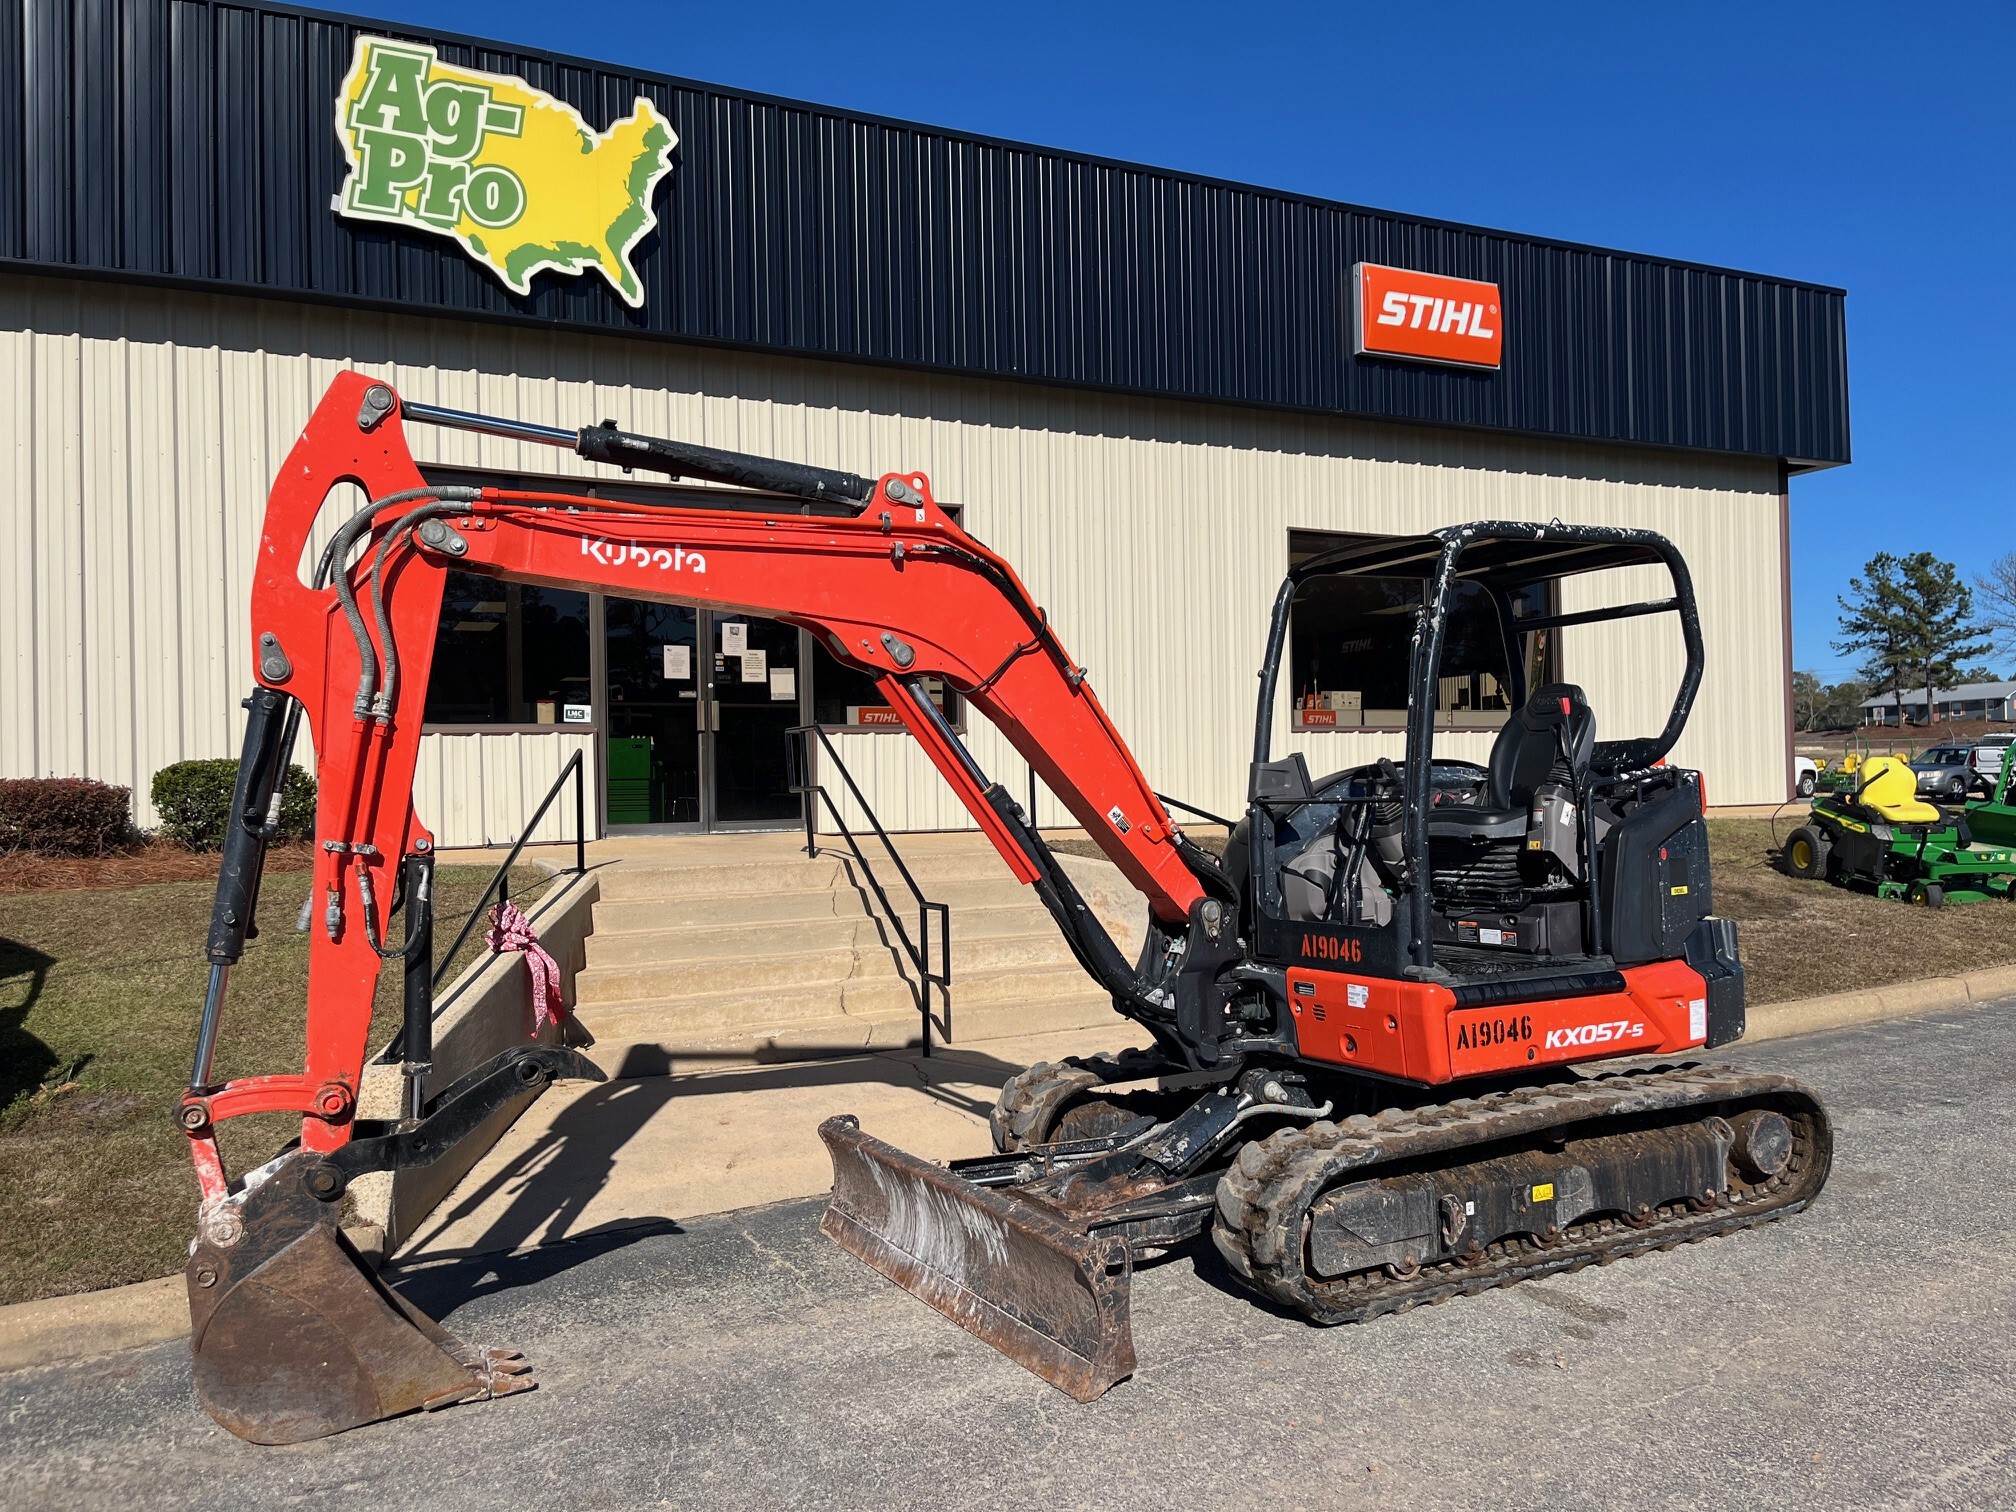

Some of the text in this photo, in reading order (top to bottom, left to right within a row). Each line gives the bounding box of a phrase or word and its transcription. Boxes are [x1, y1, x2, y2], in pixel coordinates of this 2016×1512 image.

[349, 46, 524, 164] Ag-
[351, 127, 525, 228] Pro
[1377, 291, 1494, 339] STIHL
[581, 534, 706, 574] Kubota
[1341, 637, 1374, 654] STIHL
[863, 712, 900, 723] STIHL
[1307, 714, 1335, 724] STIHL
